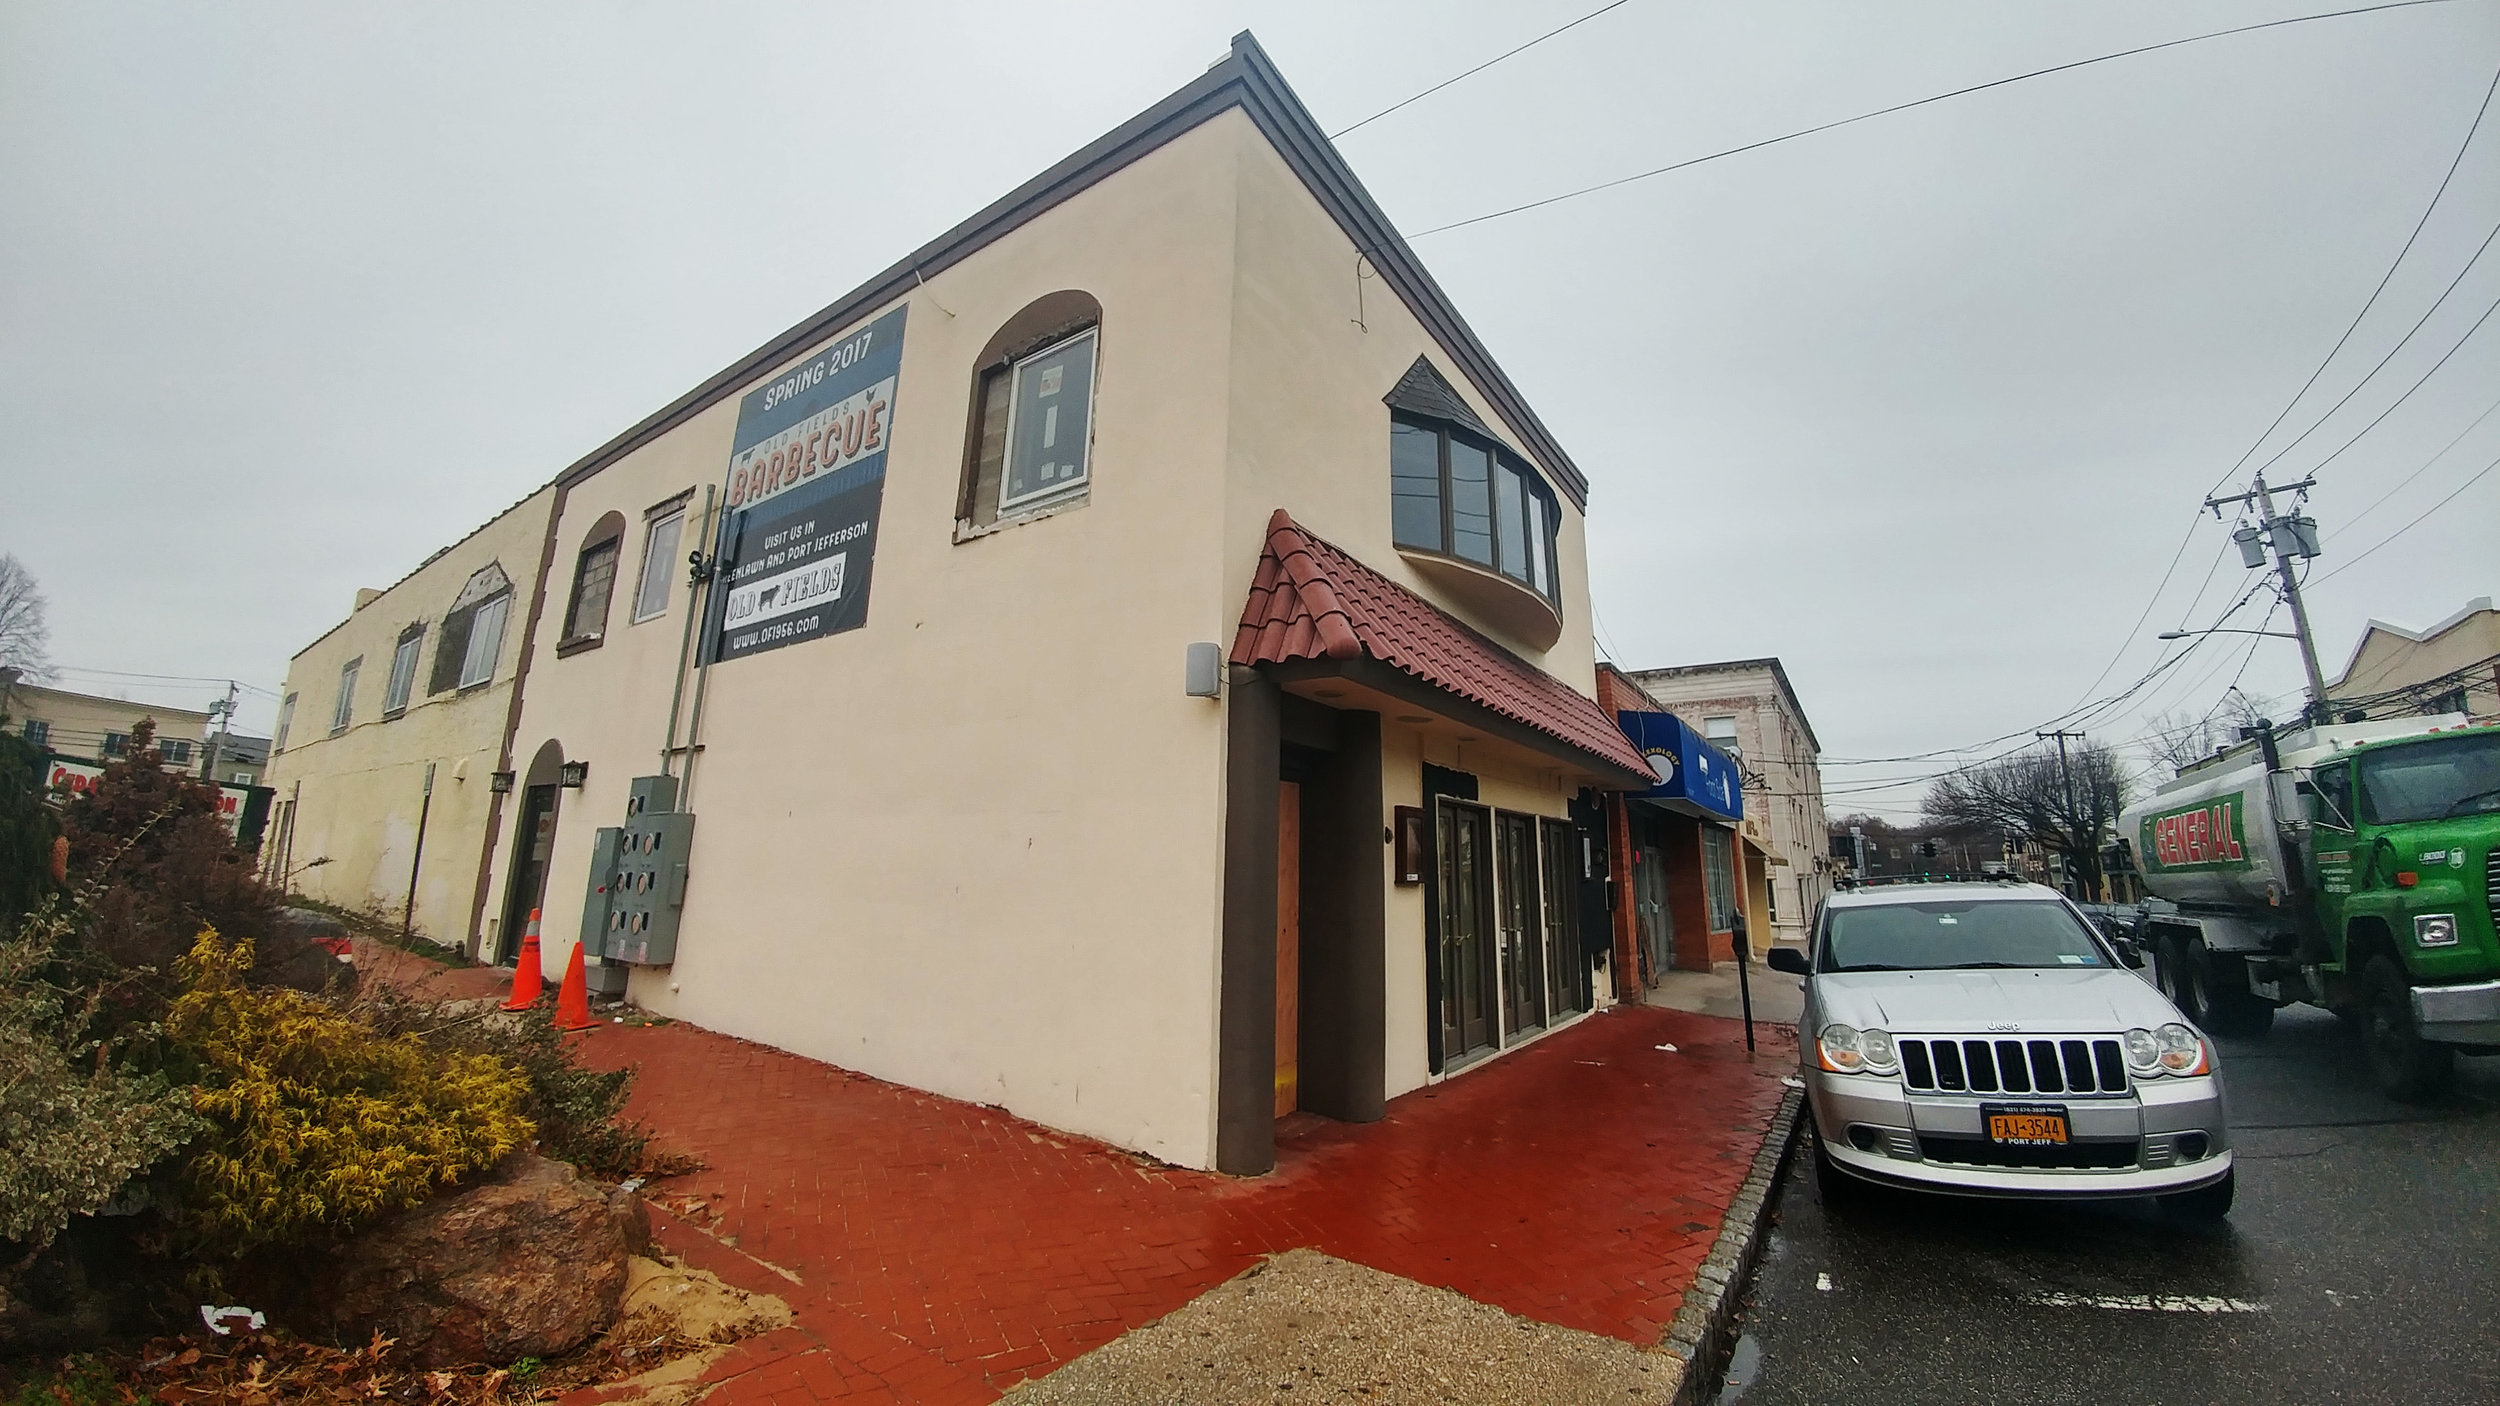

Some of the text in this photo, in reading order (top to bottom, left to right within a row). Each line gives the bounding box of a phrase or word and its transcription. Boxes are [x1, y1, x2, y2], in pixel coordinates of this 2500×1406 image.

[764, 331, 873, 411] SPRING 2017
[731, 400, 886, 507] BARBECUE
[764, 401, 850, 454] OLD FIELDS
[764, 519, 816, 550] VISIT US IN
[767, 552, 785, 568] AND
[787, 541, 812, 562] PORT
[814, 520, 869, 552] JEFFERSON
[728, 563, 842, 622] OLD FIELDS
[2155, 802, 2244, 868] GENERAL
[1987, 1020, 2021, 1032] Jeep
